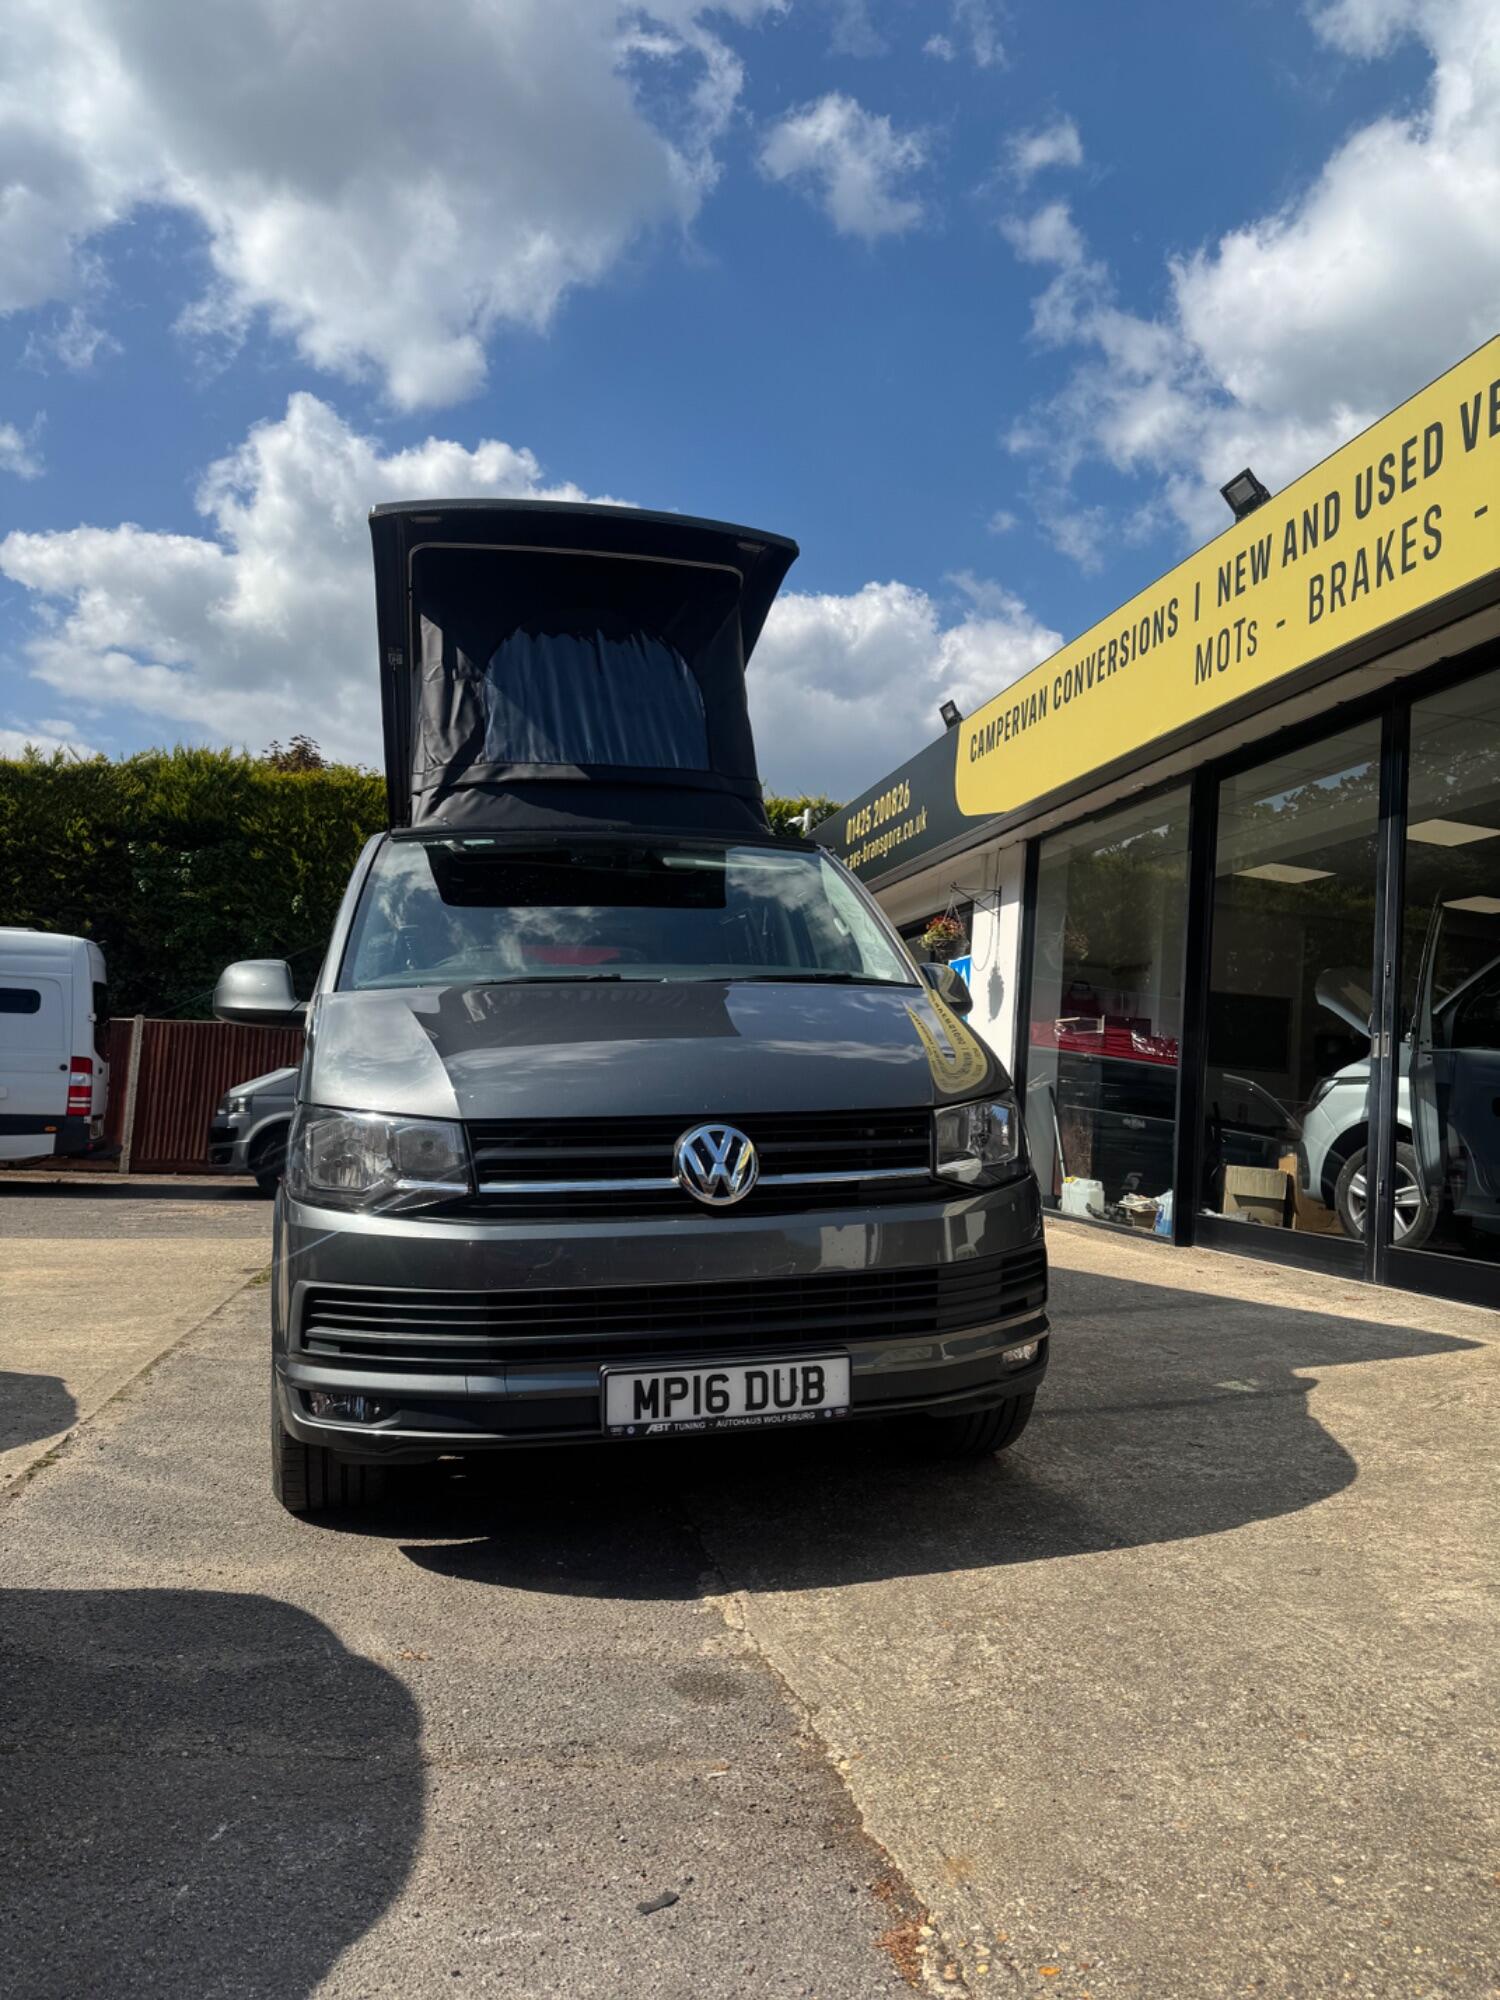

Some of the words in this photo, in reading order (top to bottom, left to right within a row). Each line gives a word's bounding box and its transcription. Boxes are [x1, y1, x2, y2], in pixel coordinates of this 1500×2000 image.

[970, 685, 1048, 762] CAMPERVAN
[1053, 597, 1179, 710] CONVERSIONS
[1217, 533, 1273, 607] NEW
[1282, 490, 1341, 568] AND
[1355, 421, 1444, 520] USED
[1194, 617, 1257, 685] MOTs
[1309, 504, 1442, 625] BRAKES
[846, 804, 872, 845] 01425
[873, 778, 911, 828] 200826
[633, 1373, 730, 1420] MP16
[744, 1365, 825, 1411] DUB
[674, 1421, 706, 1432] TUNING
[716, 1415, 761, 1428] AUTOHAUS
[763, 1411, 816, 1425] WOLFSBURG
